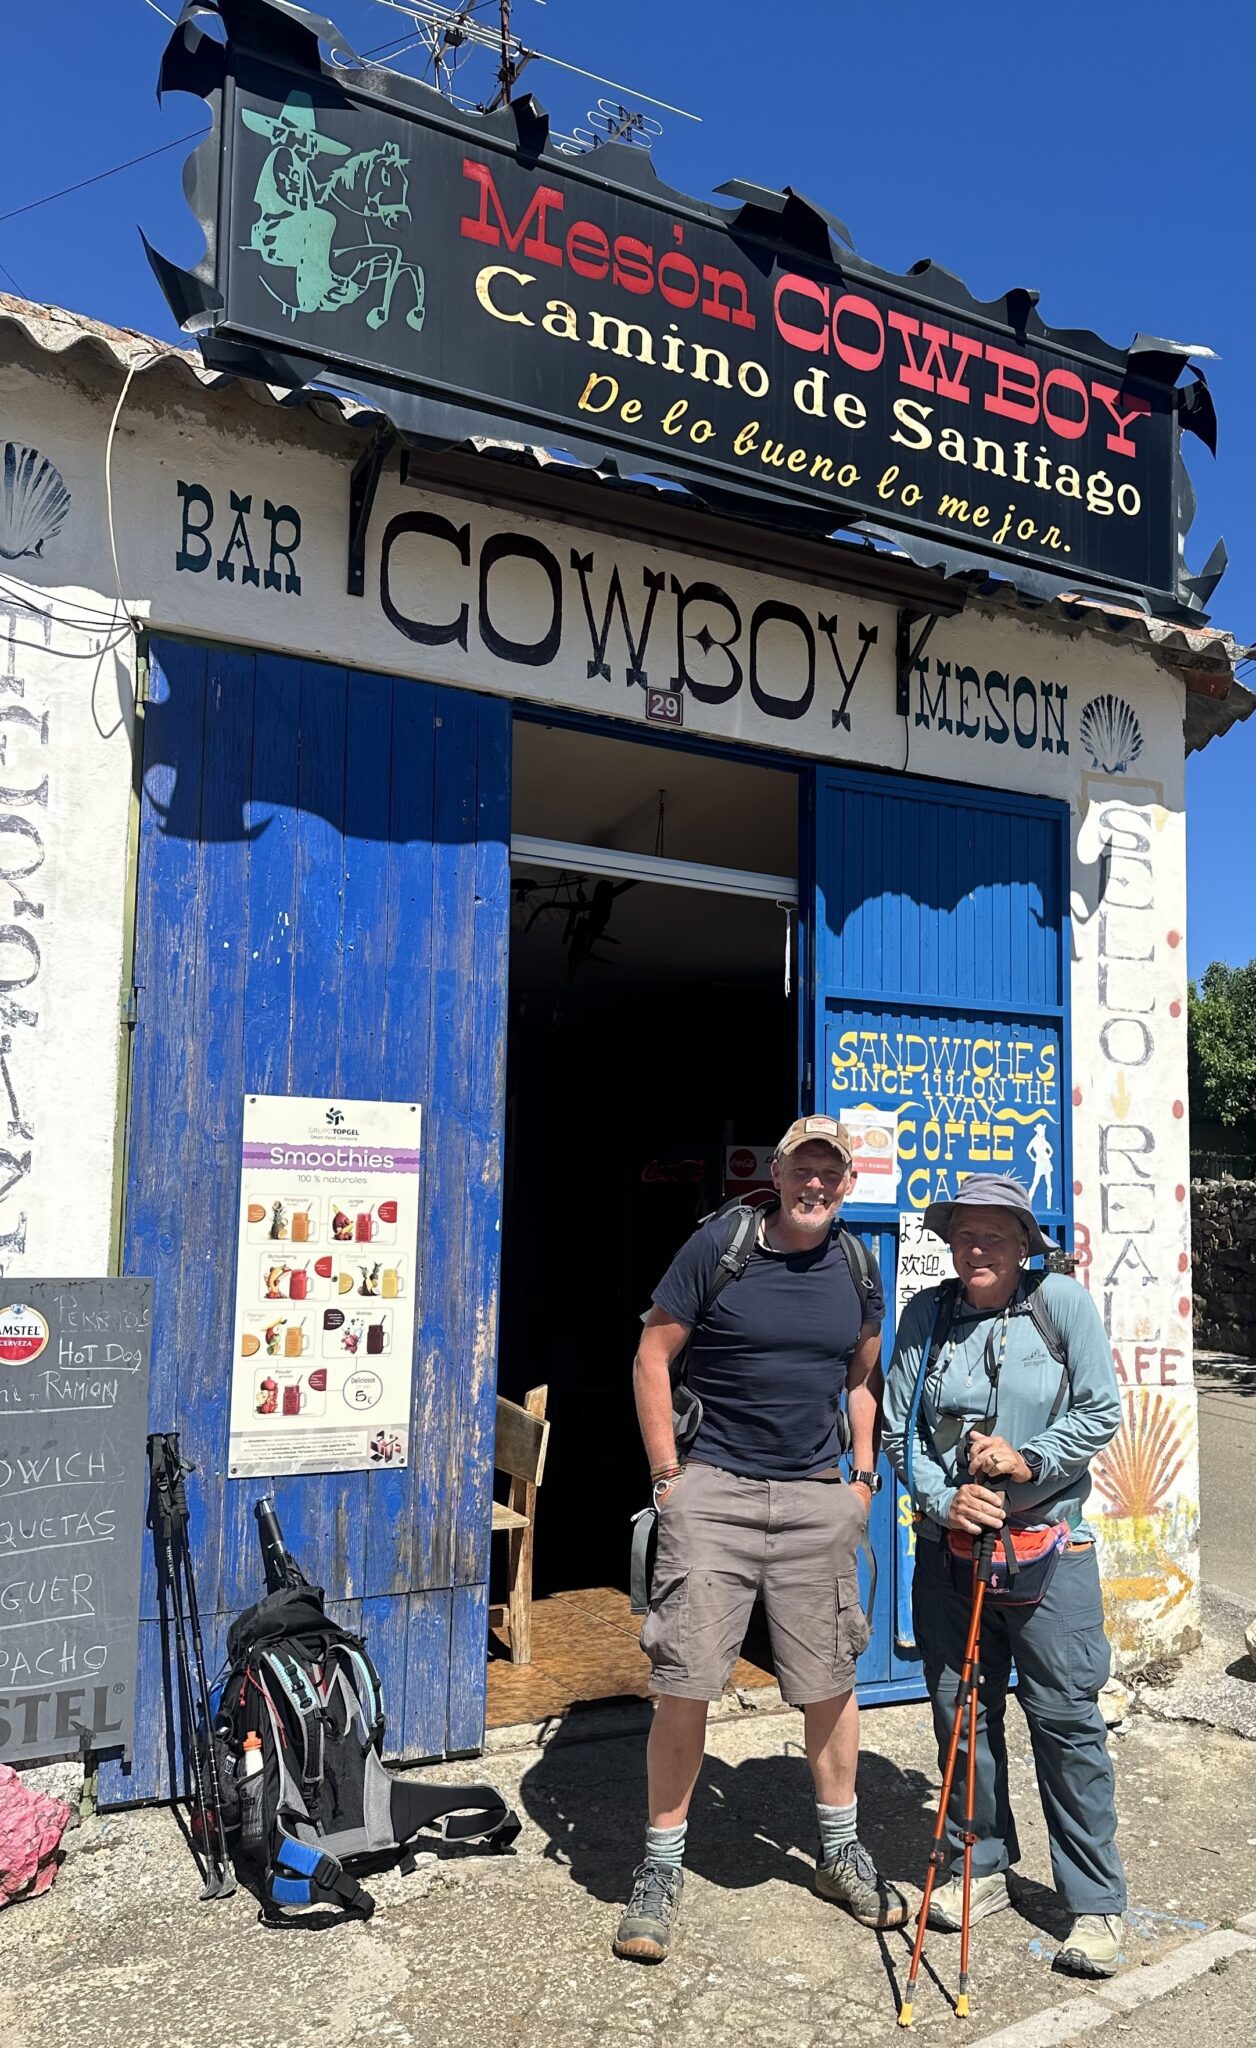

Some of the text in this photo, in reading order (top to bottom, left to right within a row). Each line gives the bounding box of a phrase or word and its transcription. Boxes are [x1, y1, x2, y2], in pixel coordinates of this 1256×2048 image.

[460, 160, 1153, 458] Mesón COWBOY
[475, 265, 1142, 517] Camino de Santiago
[577, 372, 643, 424] De
[662, 399, 717, 445] lo
[733, 421, 860, 488] bueno
[877, 465, 922, 507] lo
[176, 480, 302, 597] BAR
[380, 510, 879, 733] COWBOY
[651, 694, 678, 718] 29
[913, 655, 1070, 756] MESON
[831, 1031, 1056, 1082] SANDWICHES
[831, 1067, 1056, 1105] SINCE 1991 ON THE
[1098, 807, 1162, 1343] SELLO REAL
[270, 1147, 395, 1169] Smoothies
[925, 1095, 998, 1125] WAY
[298, 1174, 312, 1184] 100
[322, 1176, 368, 1184] naturales
